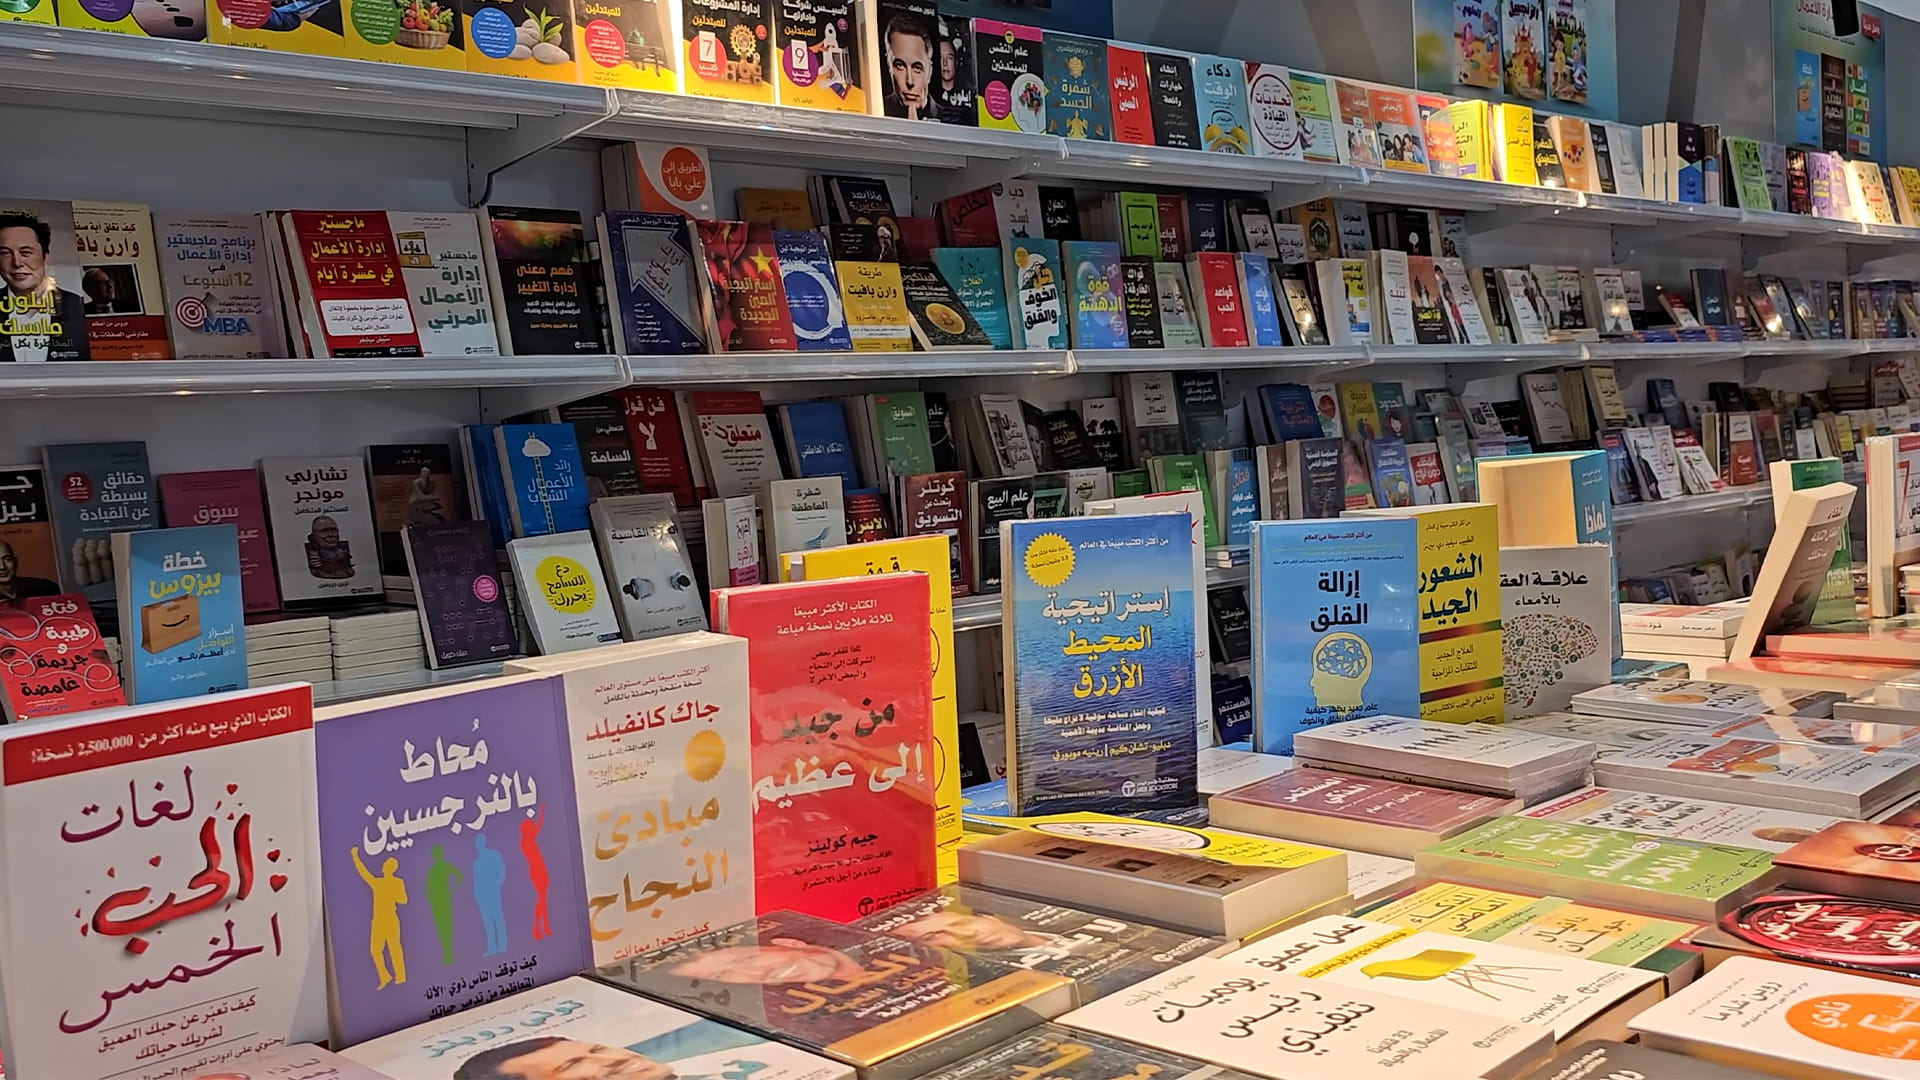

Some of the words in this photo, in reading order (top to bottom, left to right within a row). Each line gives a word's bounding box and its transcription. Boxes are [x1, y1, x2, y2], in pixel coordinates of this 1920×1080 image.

[584, 4, 622, 18] للمبتدئين
[814, 4, 848, 15] تأسيس
[691, 15, 726, 28] للمبتدئين
[783, 25, 817, 37] للمبتدئين
[701, 39, 712, 56] 7
[794, 47, 805, 64] 9
[988, 44, 1013, 54] النفس
[1014, 46, 1029, 57] علم
[991, 61, 1028, 74] للمبتدئين
[1159, 65, 1178, 77] إنشاء
[1061, 78, 1091, 95] شفرة
[1159, 80, 1183, 92] خيارات
[1204, 82, 1238, 100] الوقت
[950, 88, 972, 109] إيلون
[1059, 97, 1093, 112] الجسد
[1162, 95, 1182, 108] رائعة
[1255, 93, 1291, 107] تحديات
[1263, 109, 1289, 122] القيادة
[668, 177, 682, 188] بابا
[683, 180, 702, 194] علي
[1008, 189, 1024, 198] دب
[317, 215, 365, 233] ماجستير
[166, 236, 217, 248] ماجستير
[220, 236, 256, 252] برنامج
[311, 239, 353, 260] الأعمال
[356, 241, 386, 259] إدارة
[177, 251, 221, 261] الأعمال
[223, 252, 251, 265] إدارة
[438, 252, 478, 262] ماجستير
[208, 263, 226, 273] في
[316, 264, 338, 285] أيام
[341, 262, 376, 281] عشرة
[381, 264, 395, 286] في
[441, 266, 481, 286] إدارة
[516, 265, 547, 277] معنى
[550, 265, 574, 278] فهم
[857, 267, 882, 279] طريقة
[517, 281, 550, 295] التغيير
[553, 282, 577, 297] إدارة
[963, 278, 984, 287] العلاج
[1088, 275, 1109, 293] قوة
[419, 287, 485, 305] الأعمال
[847, 284, 876, 299] بافيت
[877, 286, 897, 299] وارن
[1024, 286, 1057, 306] الخوف
[1214, 287, 1233, 298] قواعد
[0, 290, 56, 315] إيلون
[749, 294, 776, 307] الصين
[1079, 298, 1122, 312] الدهشة
[1216, 300, 1235, 313] الحب
[740, 307, 779, 321] الجديدة
[1023, 308, 1058, 331] والقلق
[0, 317, 63, 335] ماسك
[202, 318, 253, 334] MBA
[648, 396, 665, 416] فن
[928, 404, 944, 415] علم
[638, 421, 658, 450] لا
[590, 449, 632, 464] السامة
[69, 477, 83, 486] 52
[103, 472, 145, 489] حقائق
[285, 466, 348, 486] تشارلي
[527, 476, 575, 492] الأعمال
[293, 489, 344, 504] مونجر
[796, 487, 822, 500] شفرة
[918, 478, 955, 498] كوتلر
[1011, 488, 1029, 502] علم
[101, 490, 147, 505] بسيطة
[987, 492, 1009, 509] البيع
[79, 506, 128, 522] القيادة
[132, 505, 150, 519] عن
[791, 501, 828, 513] العاطفة
[914, 510, 963, 529] التسويق
[611, 527, 649, 544] القاسية
[1125, 538, 1144, 547] الكتب
[1079, 540, 1099, 550] العالم
[163, 551, 207, 573] خطة
[555, 564, 570, 577] دع
[1418, 552, 1483, 594] الشعور
[1499, 572, 1530, 587] العق
[1533, 570, 1588, 586] علاقة
[150, 572, 221, 600] بيزوس
[546, 575, 586, 593] التسامح
[1318, 570, 1360, 598] إزالة
[554, 592, 587, 607] يحررك
[1042, 586, 1170, 626] إستراتيجية
[1422, 587, 1478, 625] الجيد
[1514, 592, 1561, 608] بالأمعاء
[41, 601, 78, 616] فتاة
[835, 617, 867, 631] ملايين
[869, 614, 893, 625] ثلاثة
[1310, 603, 1368, 632] القلق
[46, 624, 90, 641] طيبة
[777, 625, 804, 636] مباعة
[807, 621, 833, 632] نسخة
[57, 642, 67, 654] و
[1062, 625, 1152, 661] المحيط
[36, 654, 88, 671] جريمة
[21, 677, 80, 696] غامضة
[1072, 657, 1144, 699] الأزرق
[259, 705, 291, 726] الكتاب
[671, 699, 720, 723] جاك
[854, 697, 895, 737] من
[186, 725, 206, 737] منه
[209, 720, 227, 738] بيع
[230, 715, 256, 732] الذي
[586, 705, 666, 742] كانفيلد
[77, 734, 134, 756] 2,500,000
[138, 732, 157, 748] من
[868, 742, 926, 794] إلى
[752, 754, 857, 815] عظيم
[61, 766, 194, 843] لغات
[363, 770, 538, 855] بالنرجسيين
[804, 833, 847, 857] كولينز
[851, 831, 878, 847] جيم
[92, 801, 255, 954] الحب
[586, 848, 728, 942] النجاح
[1408, 891, 1475, 925] الذكاء
[1448, 898, 1509, 932] العاطفي
[1317, 923, 1366, 945] عمل
[519, 954, 538, 970] كيف
[1244, 941, 1320, 972] عميق
[58, 903, 283, 1034] الخمس
[494, 961, 518, 979] توقف
[469, 969, 493, 988] الناس
[1151, 976, 1271, 1024] يوميات
[428, 1003, 458, 1020] حياتك
[1278, 999, 1376, 1057] تنفيذي
[180, 1026, 223, 1048] لشريك
[135, 1041, 176, 1060] حياتك
